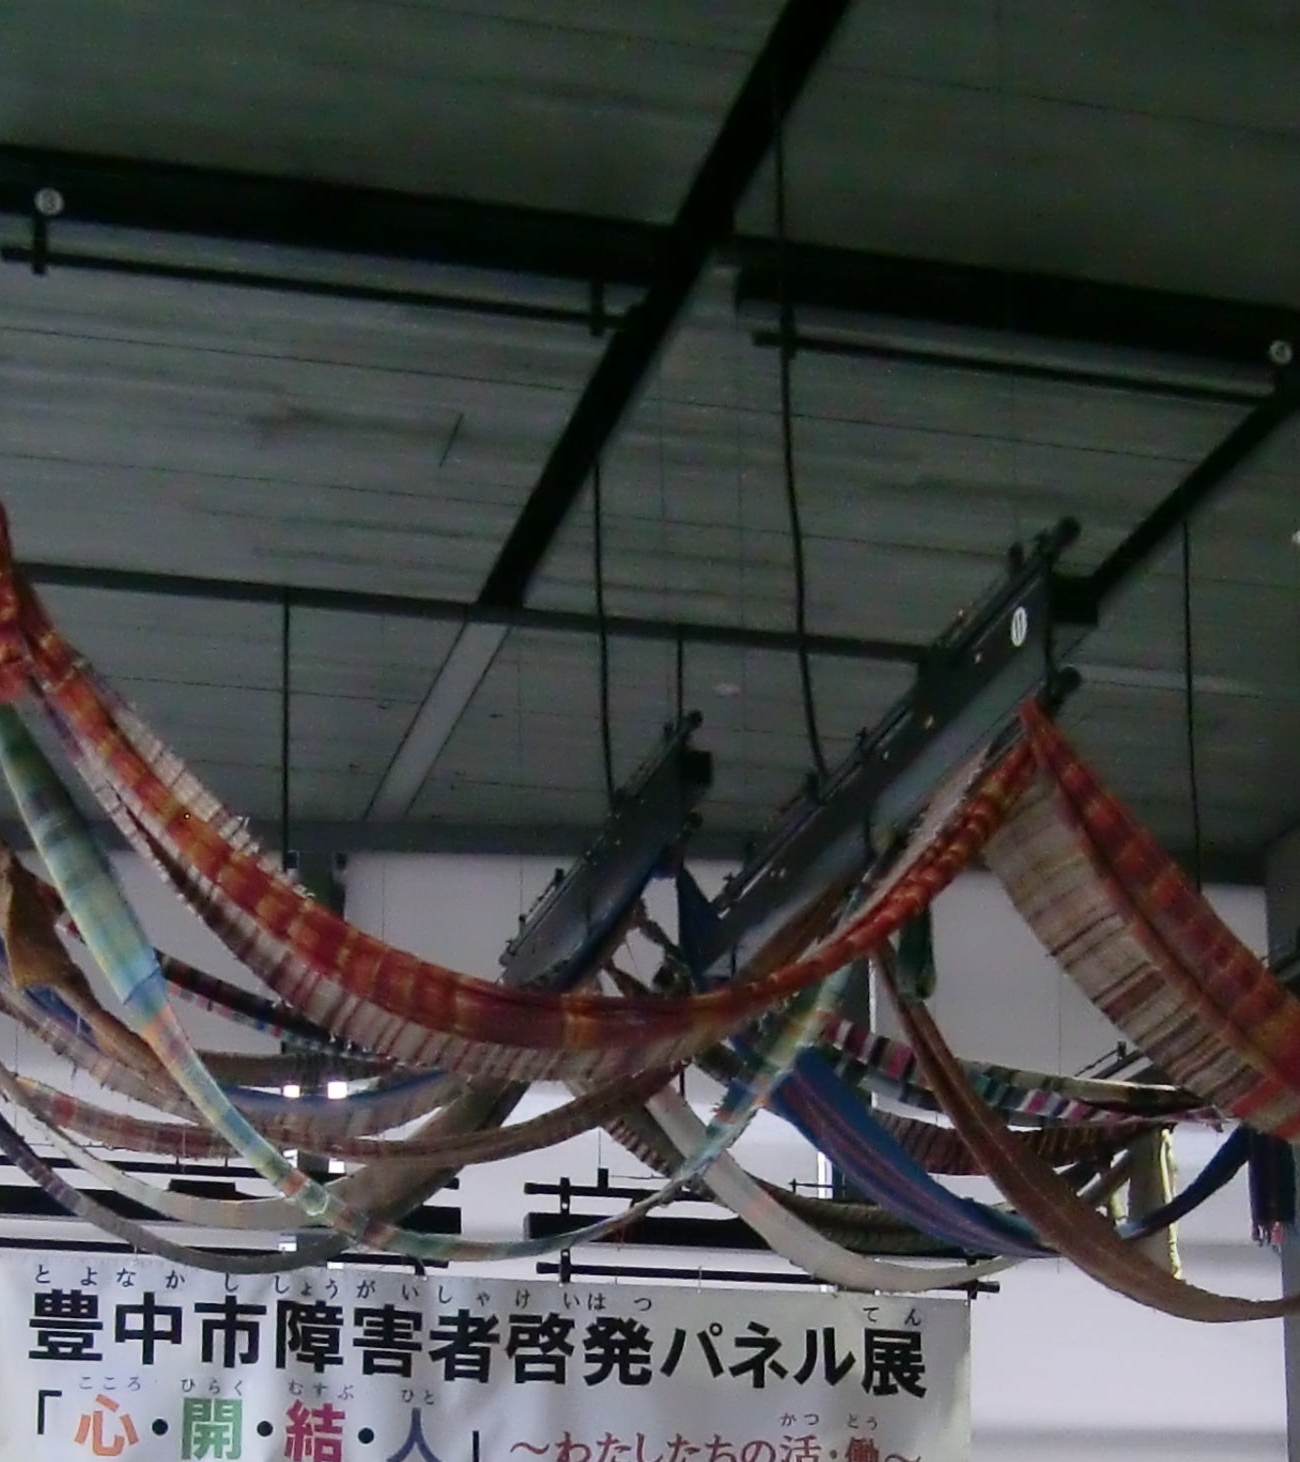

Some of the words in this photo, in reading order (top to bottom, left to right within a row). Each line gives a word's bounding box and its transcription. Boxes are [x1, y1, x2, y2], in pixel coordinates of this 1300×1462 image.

[28, 1289, 927, 1399] 豊中市障害者啓発パネル展
